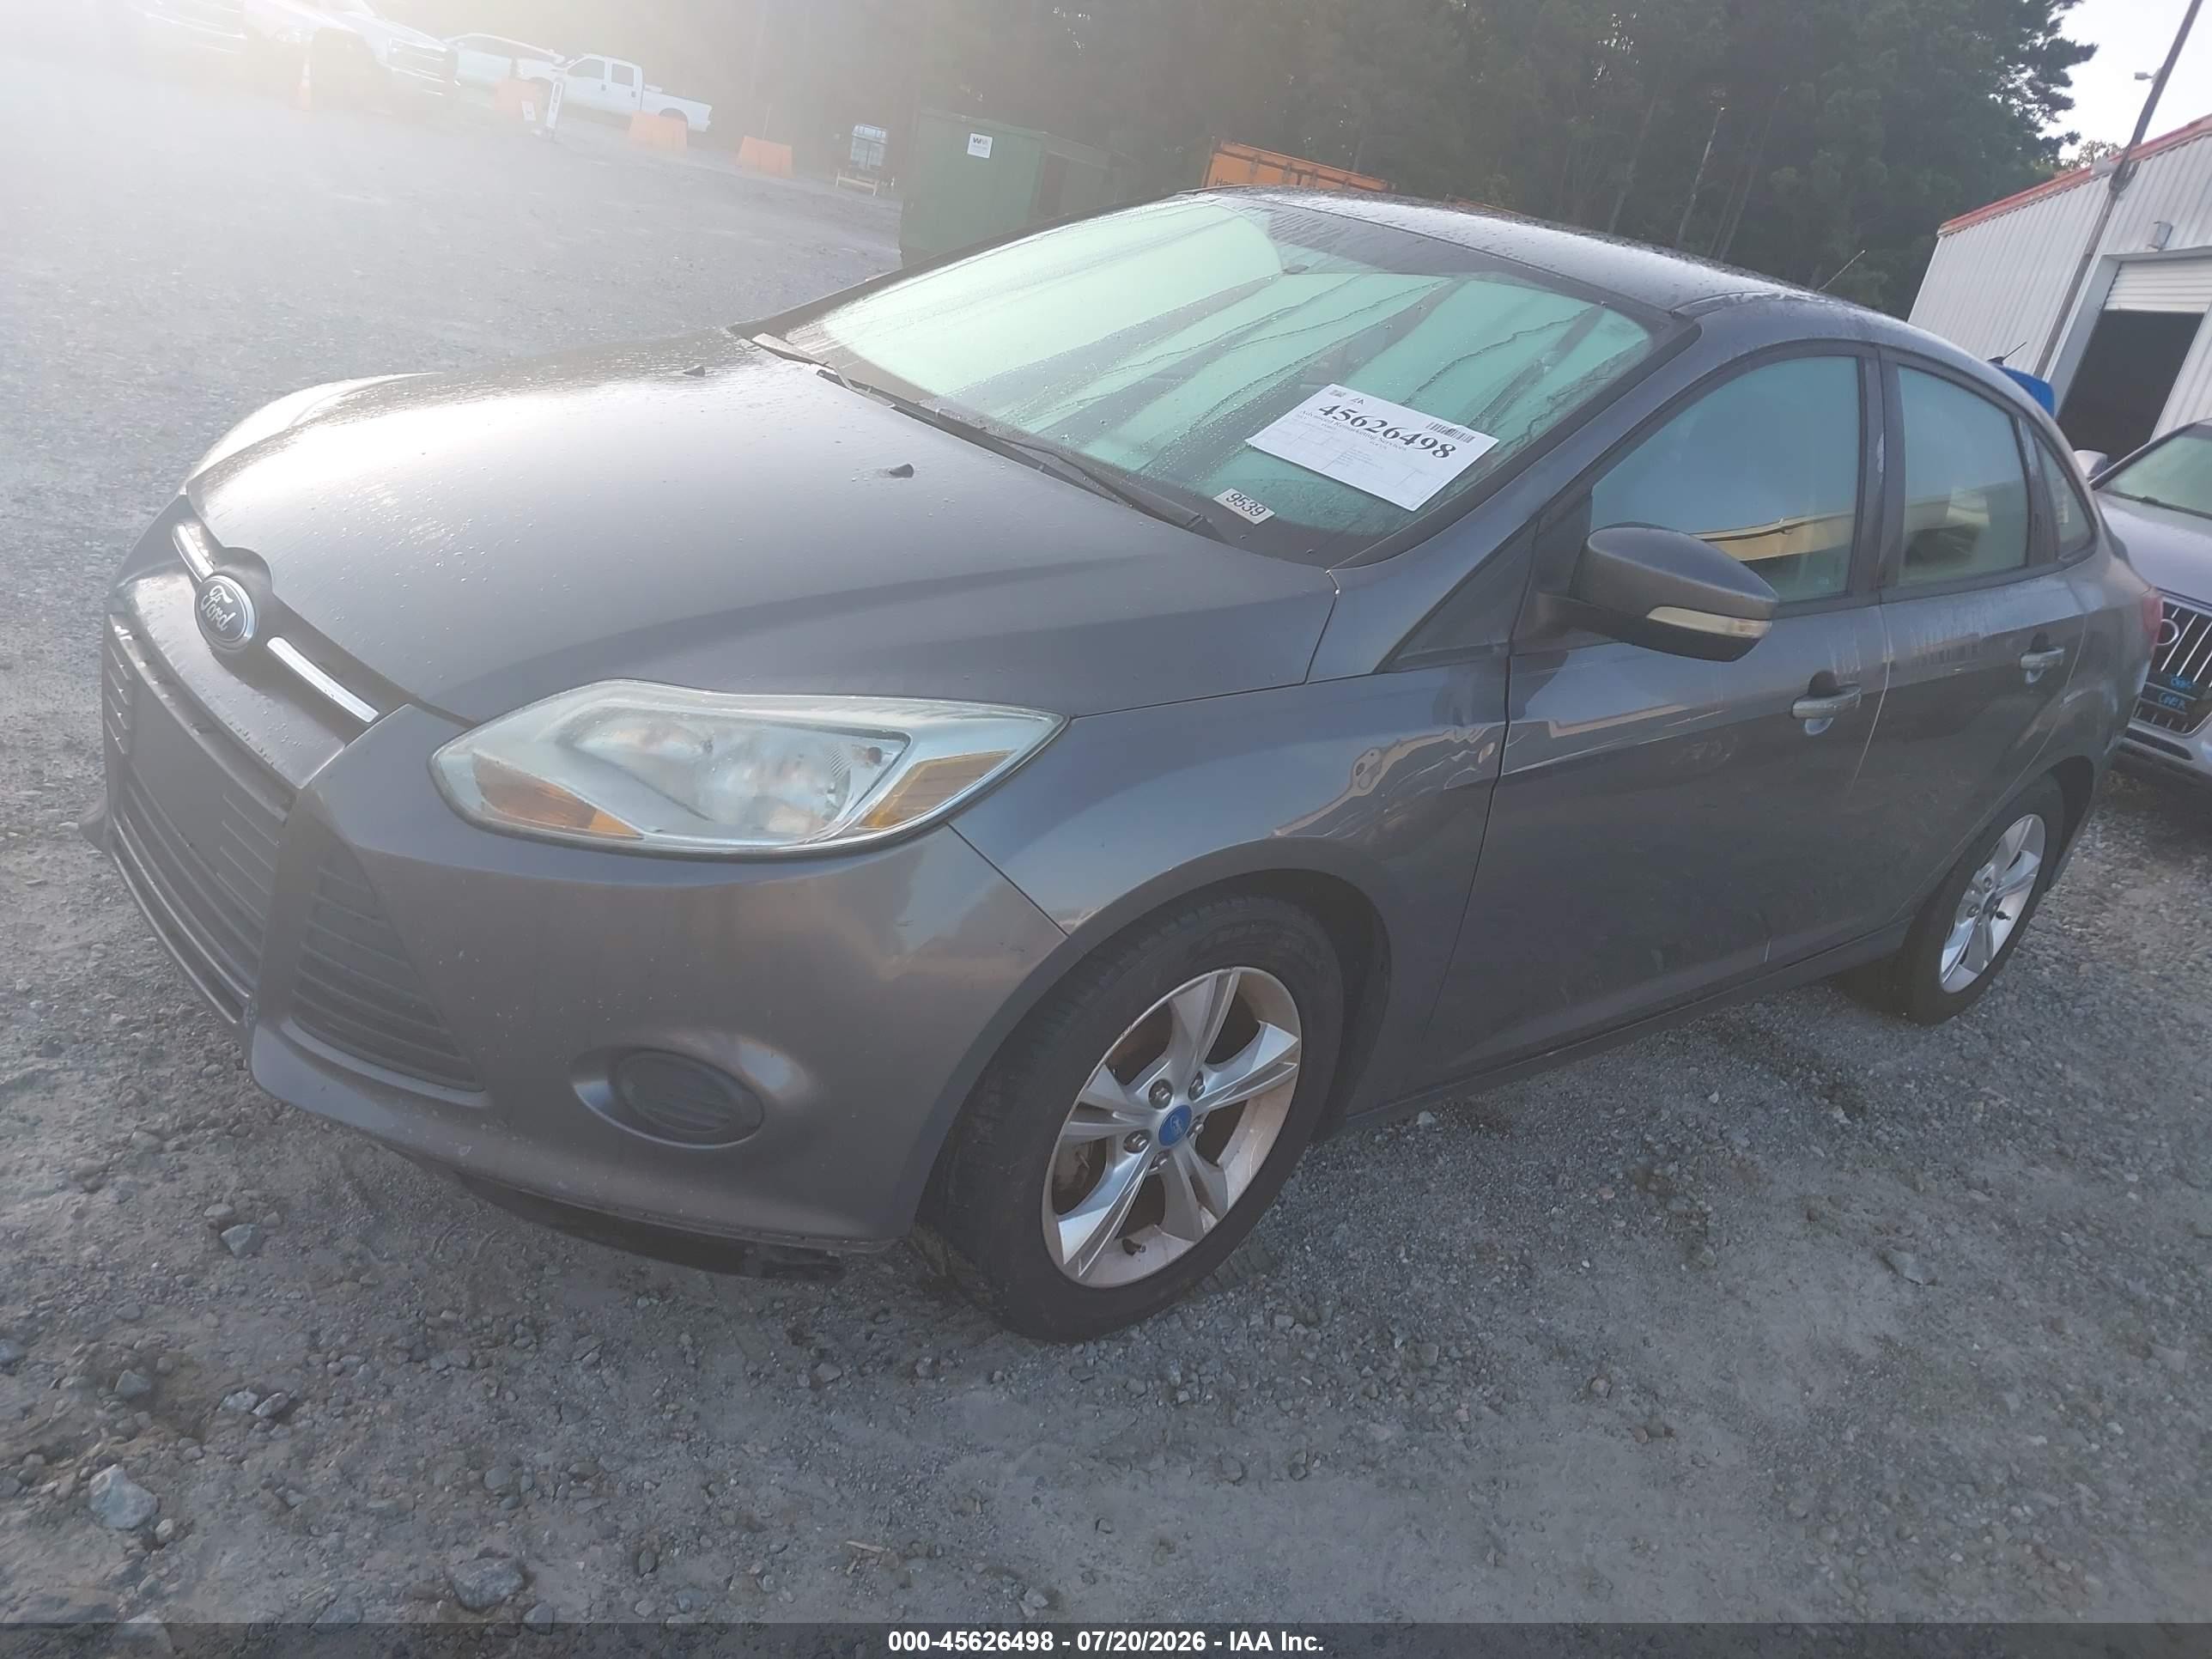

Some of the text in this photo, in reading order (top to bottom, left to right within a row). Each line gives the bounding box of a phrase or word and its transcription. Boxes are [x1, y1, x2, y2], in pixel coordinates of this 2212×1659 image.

[1319, 404, 1456, 459] 45626498
[1226, 493, 1267, 517] 9539
[200, 585, 236, 631] Ford
